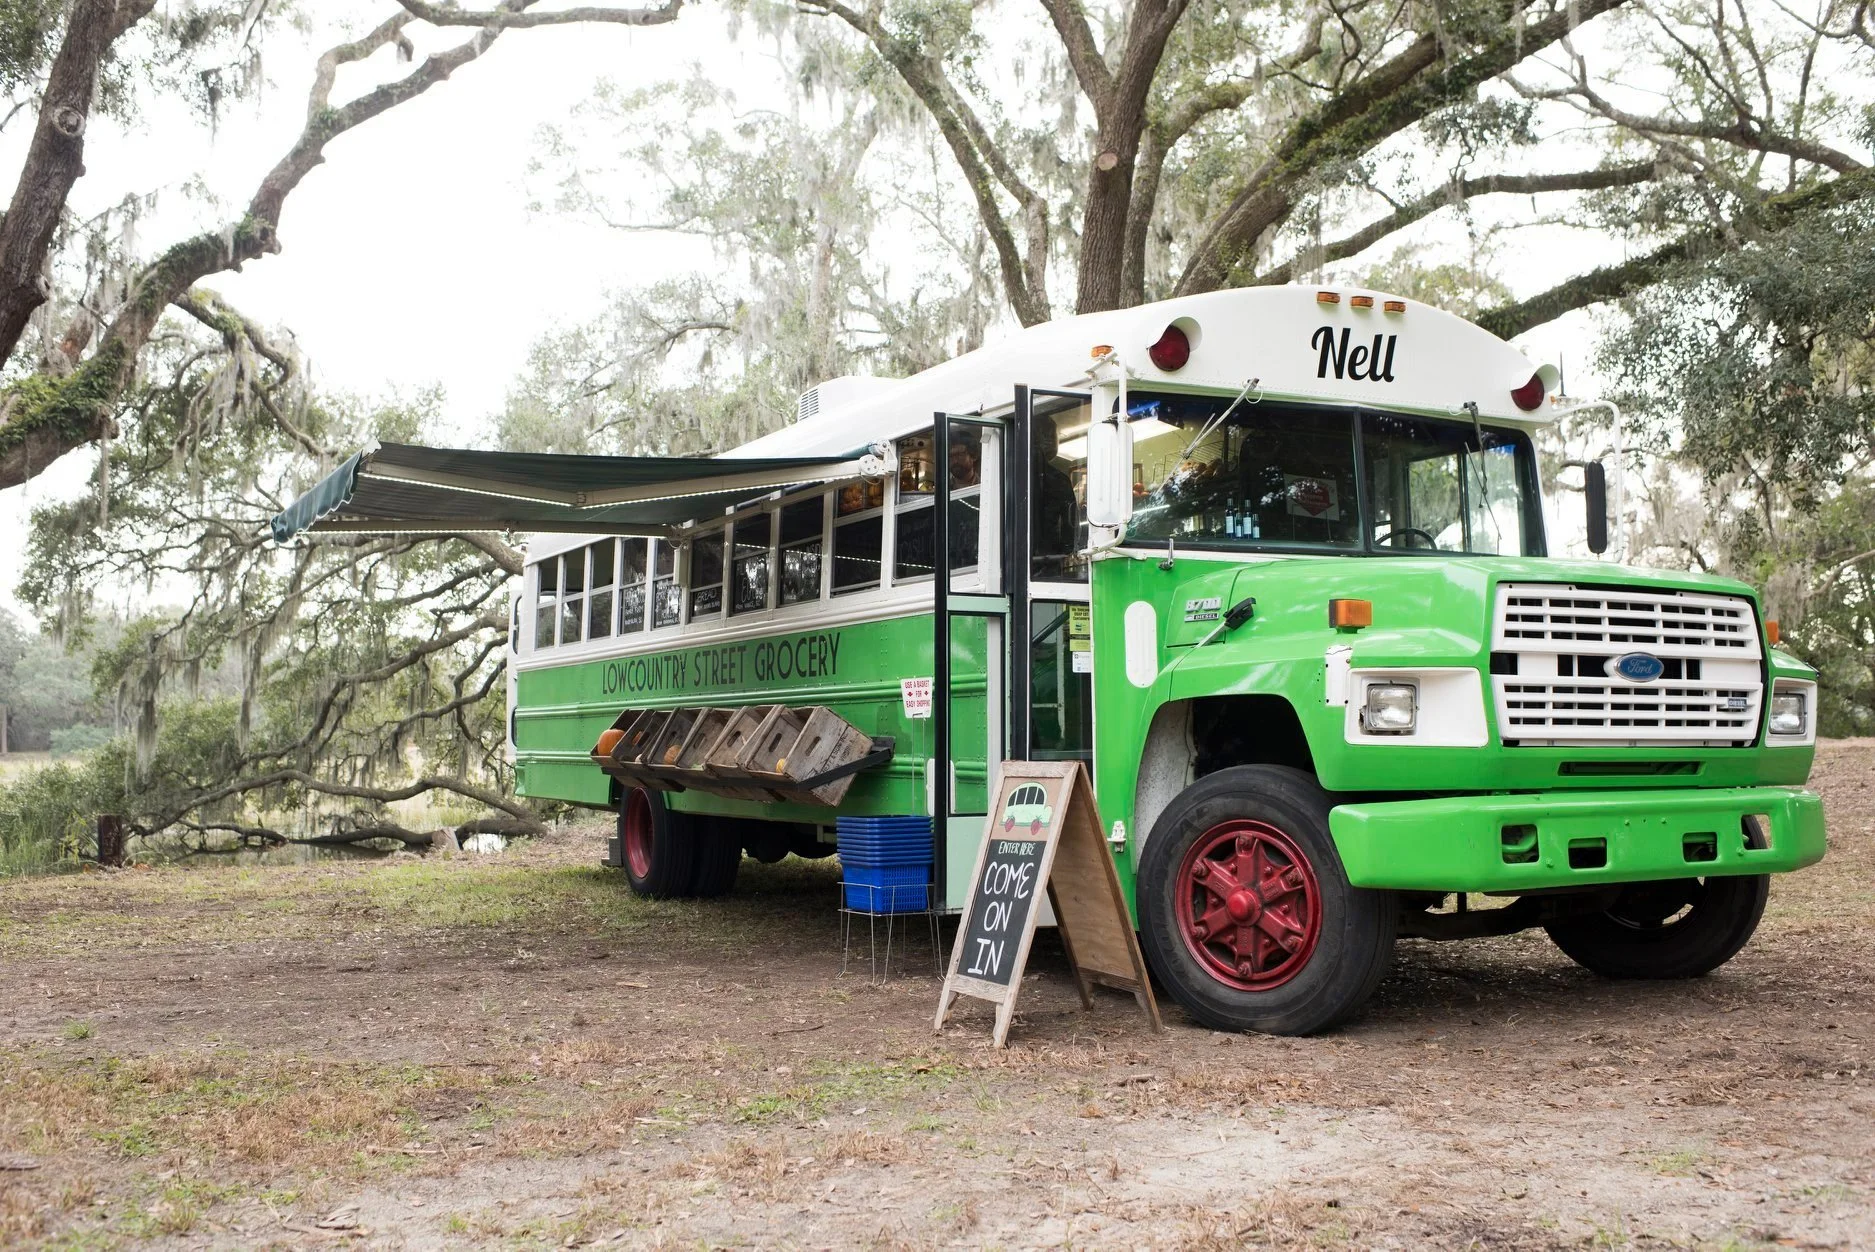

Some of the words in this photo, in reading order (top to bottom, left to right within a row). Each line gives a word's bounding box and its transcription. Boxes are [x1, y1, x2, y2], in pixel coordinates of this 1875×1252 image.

[1311, 326, 1397, 382] Nell
[602, 652, 687, 694] LOWCOUNTRY
[694, 646, 747, 686] STREET
[755, 632, 841, 681] GROCERY
[1628, 659, 1653, 674] Ford
[917, 680, 929, 688] BASKET
[998, 841, 1020, 854] ENTER
[1019, 842, 1036, 856] HERE
[984, 862, 1034, 899] COME
[984, 901, 1013, 932] ON
[967, 937, 1004, 976] IN
